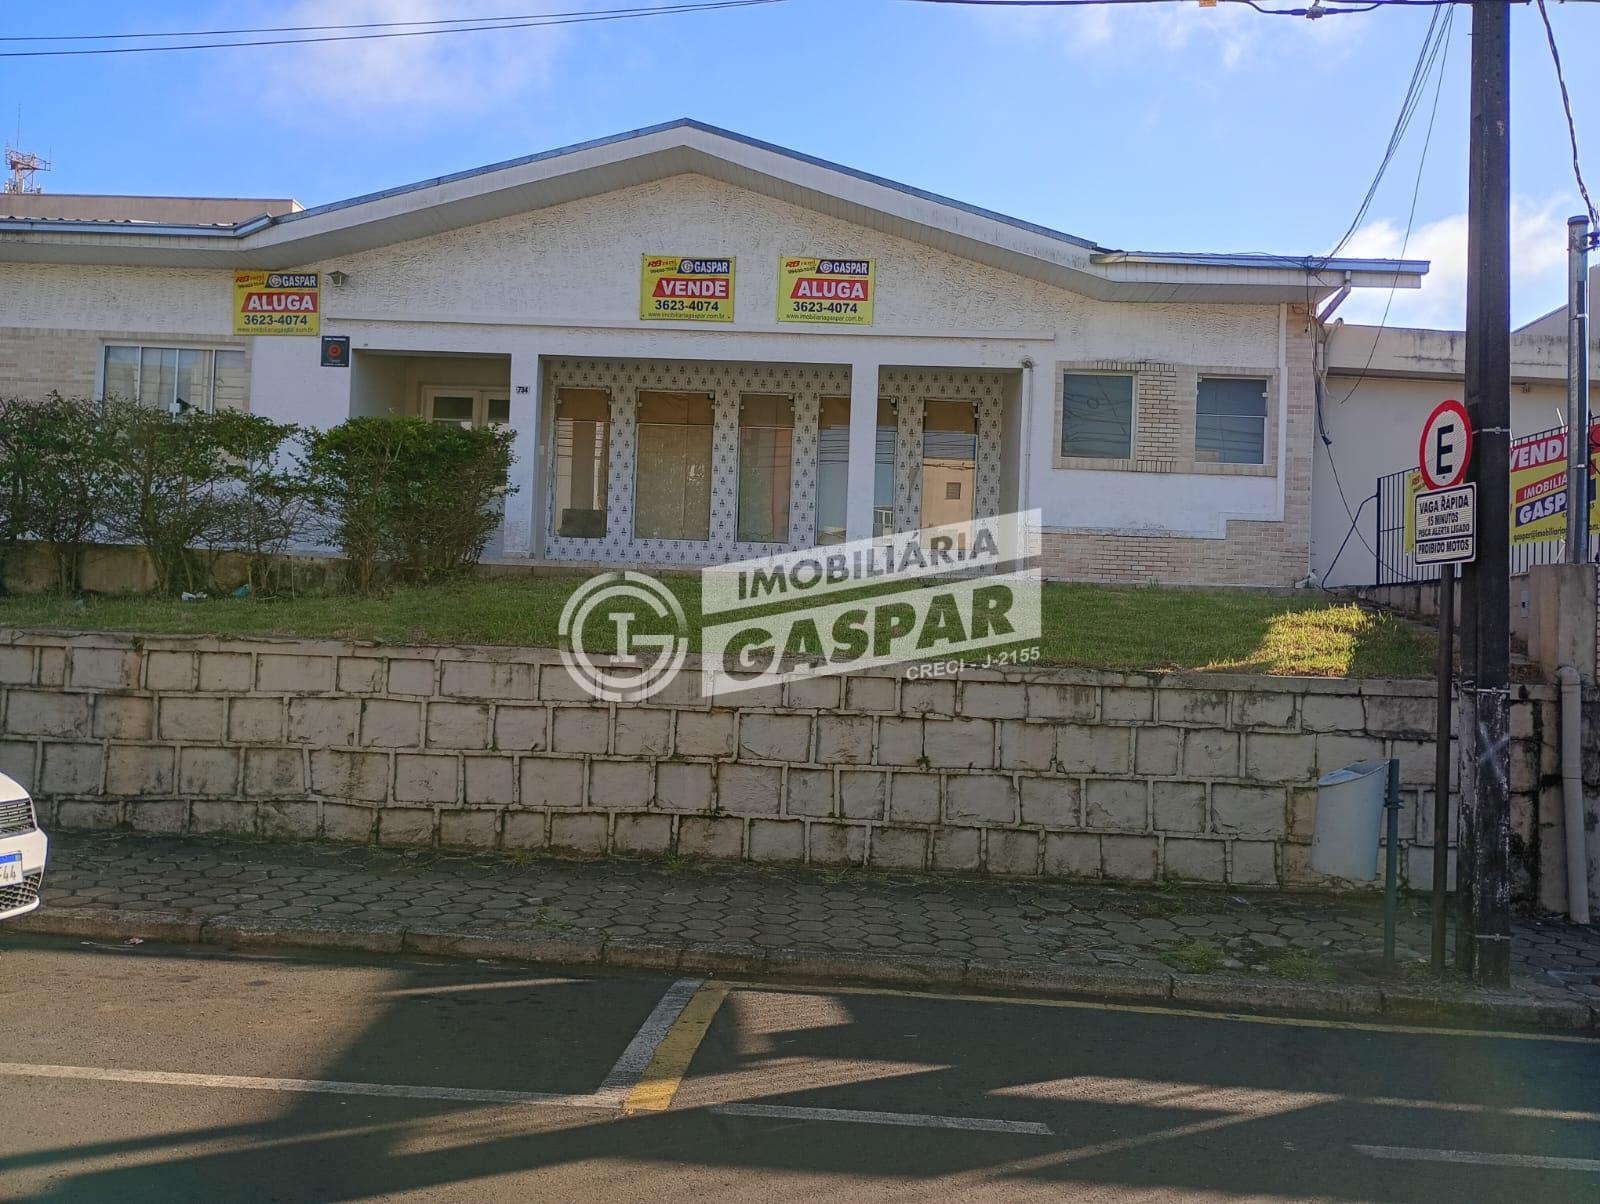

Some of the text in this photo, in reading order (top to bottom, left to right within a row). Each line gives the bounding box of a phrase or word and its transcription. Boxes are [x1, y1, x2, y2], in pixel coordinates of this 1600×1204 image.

[693, 262, 729, 273] GASPAR
[833, 262, 868, 275] GASPAR
[282, 275, 317, 287] GASPAR
[661, 280, 727, 297] VENDE
[797, 280, 865, 299] ALUGA
[248, 295, 314, 311] ALUGA
[655, 299, 719, 312] 3623-4074
[793, 301, 858, 314] 3623-4074
[243, 314, 308, 326] 3623-4074
[1436, 423, 1455, 476] E
[1419, 495, 1469, 514] VAGA RÁPIDA
[1519, 492, 1568, 524] GASP
[1428, 512, 1459, 527] 15 MINUTOS
[1432, 526, 1450, 536] ALERTA
[1450, 523, 1470, 534] LIGADO
[1418, 539, 1470, 555] PROIBIDO MOTOS
